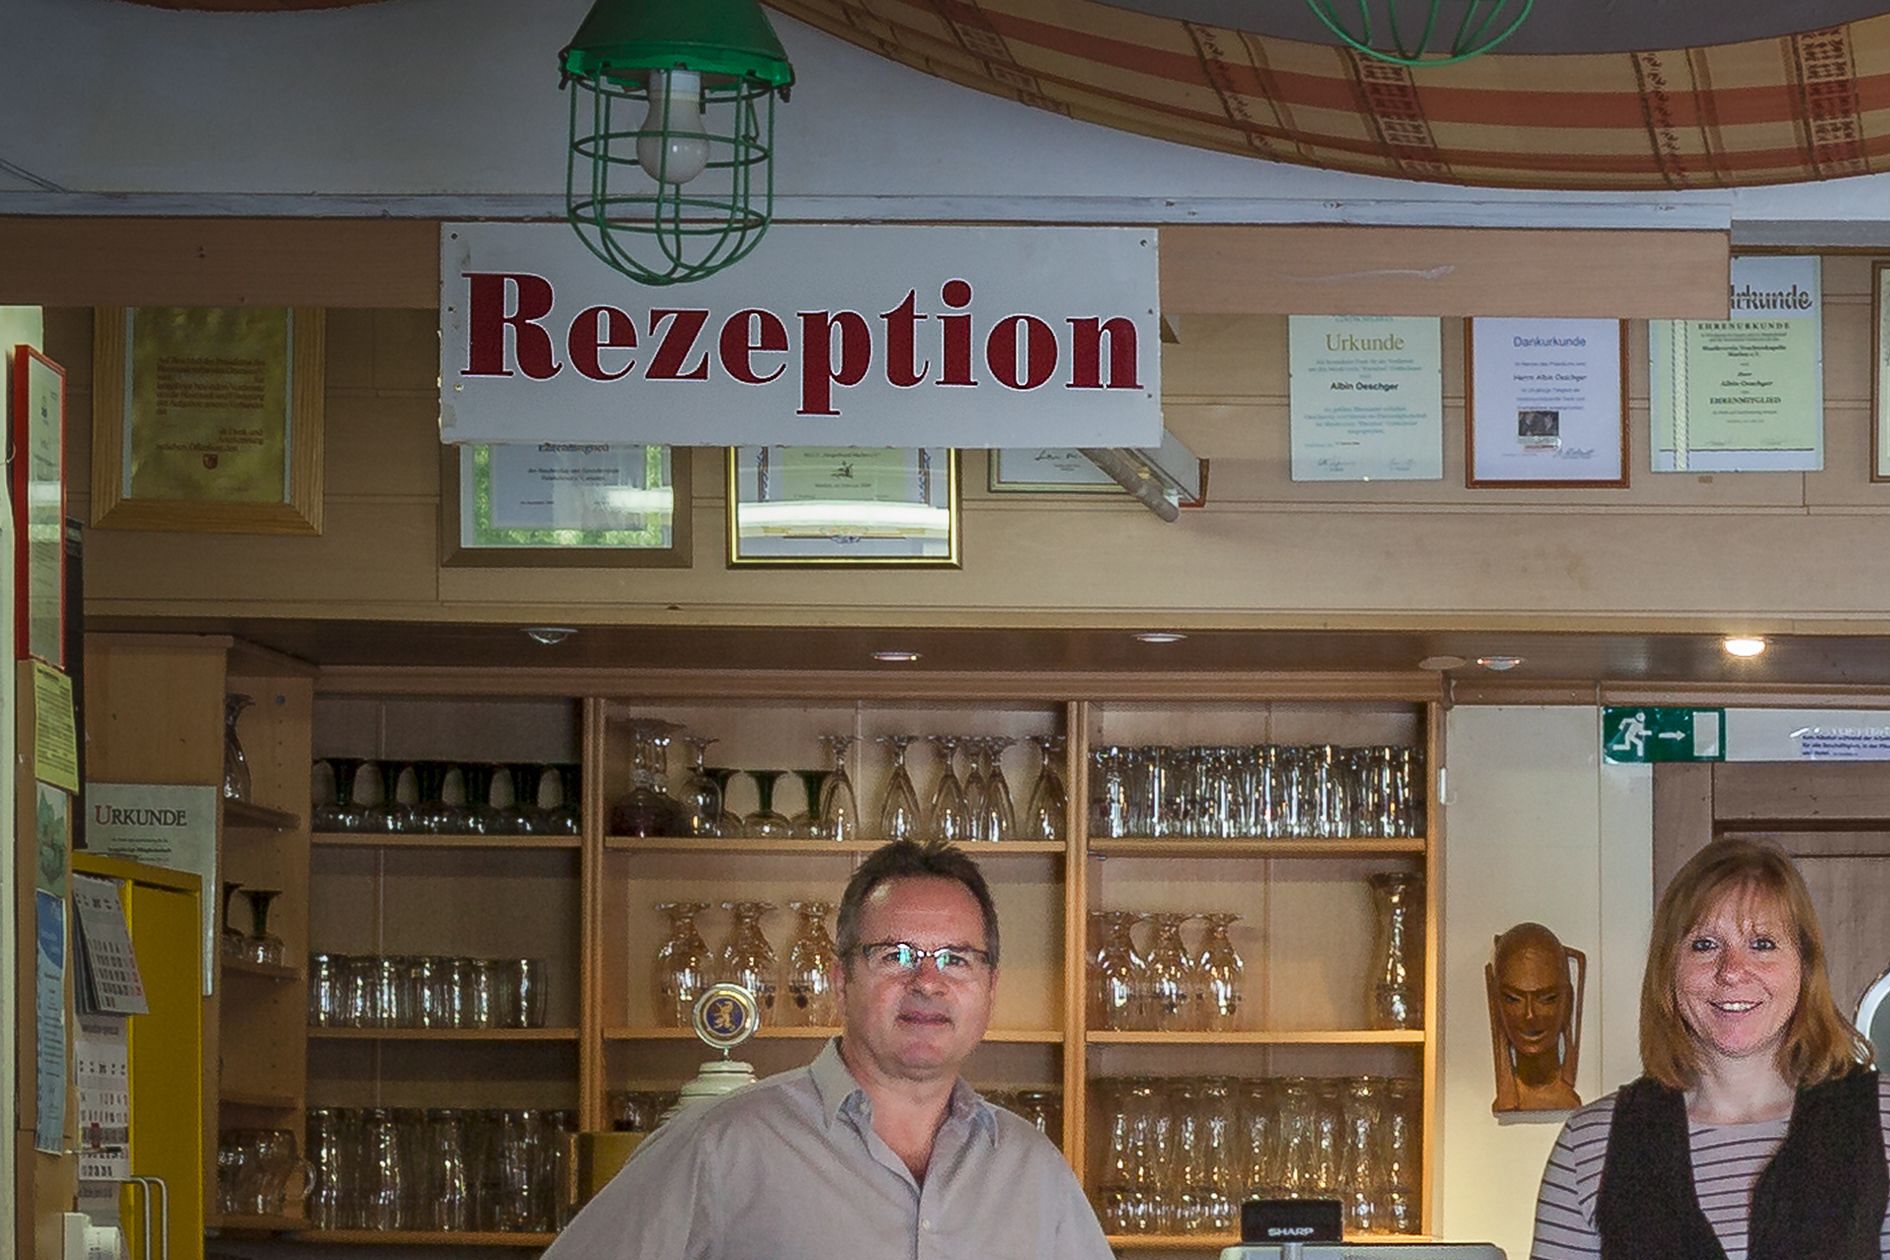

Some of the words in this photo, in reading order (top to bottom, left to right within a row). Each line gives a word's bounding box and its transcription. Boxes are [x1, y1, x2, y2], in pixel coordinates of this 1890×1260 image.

[459, 271, 1145, 417] Rezeption
[1325, 333, 1406, 352] Urkunde
[1512, 335, 1587, 348] Dankurkunde
[1329, 381, 1354, 391] Albin
[1355, 381, 1400, 392] Oeschger
[94, 804, 188, 827] URKUNDE
[1268, 1227, 1315, 1237] SHARP
